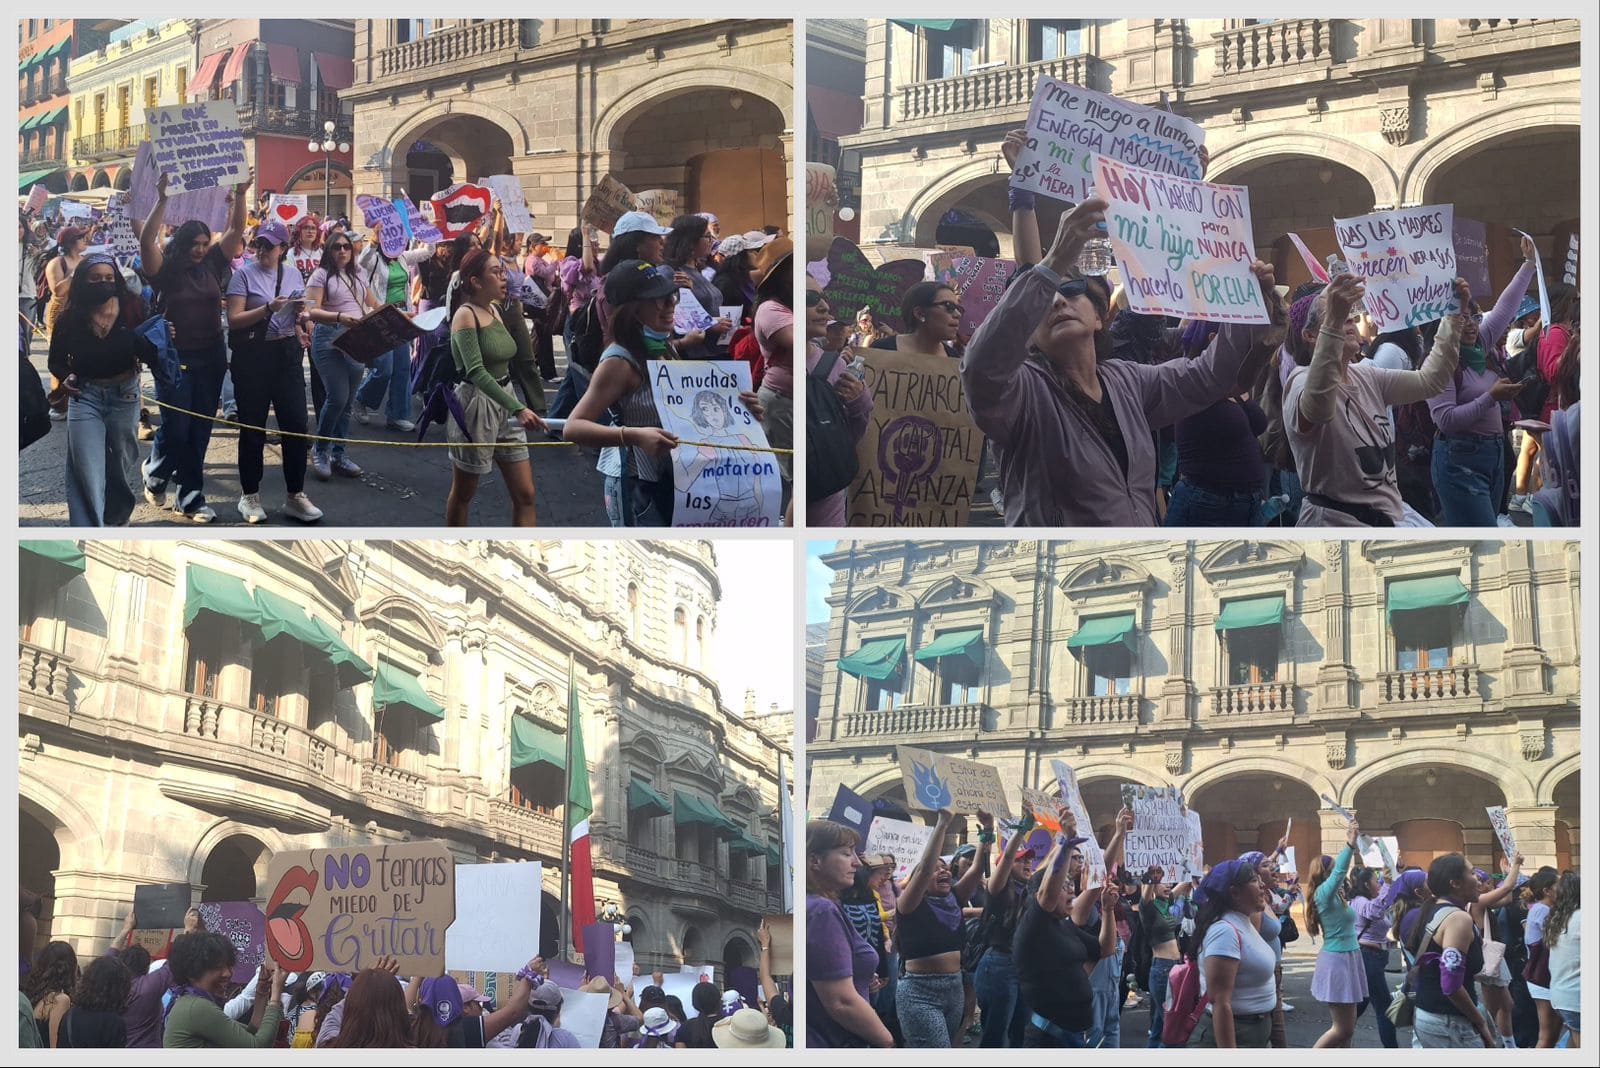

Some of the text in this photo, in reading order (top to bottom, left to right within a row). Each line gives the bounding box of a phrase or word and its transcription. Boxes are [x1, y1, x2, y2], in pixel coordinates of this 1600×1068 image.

[1084, 98, 1133, 133] niego
[1136, 117, 1150, 131] a
[1026, 137, 1039, 152] a
[1048, 140, 1074, 166] mi
[1109, 136, 1190, 181] MASCULINA
[1015, 161, 1042, 183] ser
[1045, 162, 1064, 178] la
[1038, 174, 1075, 199] MERA
[1102, 166, 1151, 211] HOY
[1150, 178, 1203, 214] MARCHO
[1212, 190, 1244, 219] CON
[370, 198, 382, 207] LA
[381, 224, 404, 239] HOY
[382, 217, 393, 226] DE
[1201, 221, 1230, 236] para
[1368, 219, 1396, 241] LAS
[1397, 212, 1443, 239] MADRES
[1114, 214, 1200, 272] mi hija
[1197, 237, 1253, 264] NUNCA
[1409, 250, 1429, 265] VER
[1429, 250, 1438, 263] A
[1435, 247, 1455, 269] SUS
[1122, 260, 1184, 303] hacerlo
[1191, 270, 1226, 306] POR
[1406, 275, 1451, 305] volver
[657, 364, 738, 390] A muchas
[667, 395, 751, 425] no las
[874, 417, 976, 463] Y CAPITAL
[702, 458, 774, 478] mataron
[686, 493, 712, 510] las
[1125, 832, 1185, 850] FEMINISMO
[1126, 852, 1179, 868] DECOLONIAL
[324, 845, 447, 904] NO tengas
[330, 893, 412, 914] MIEDO DE
[318, 912, 442, 971] Gritar
